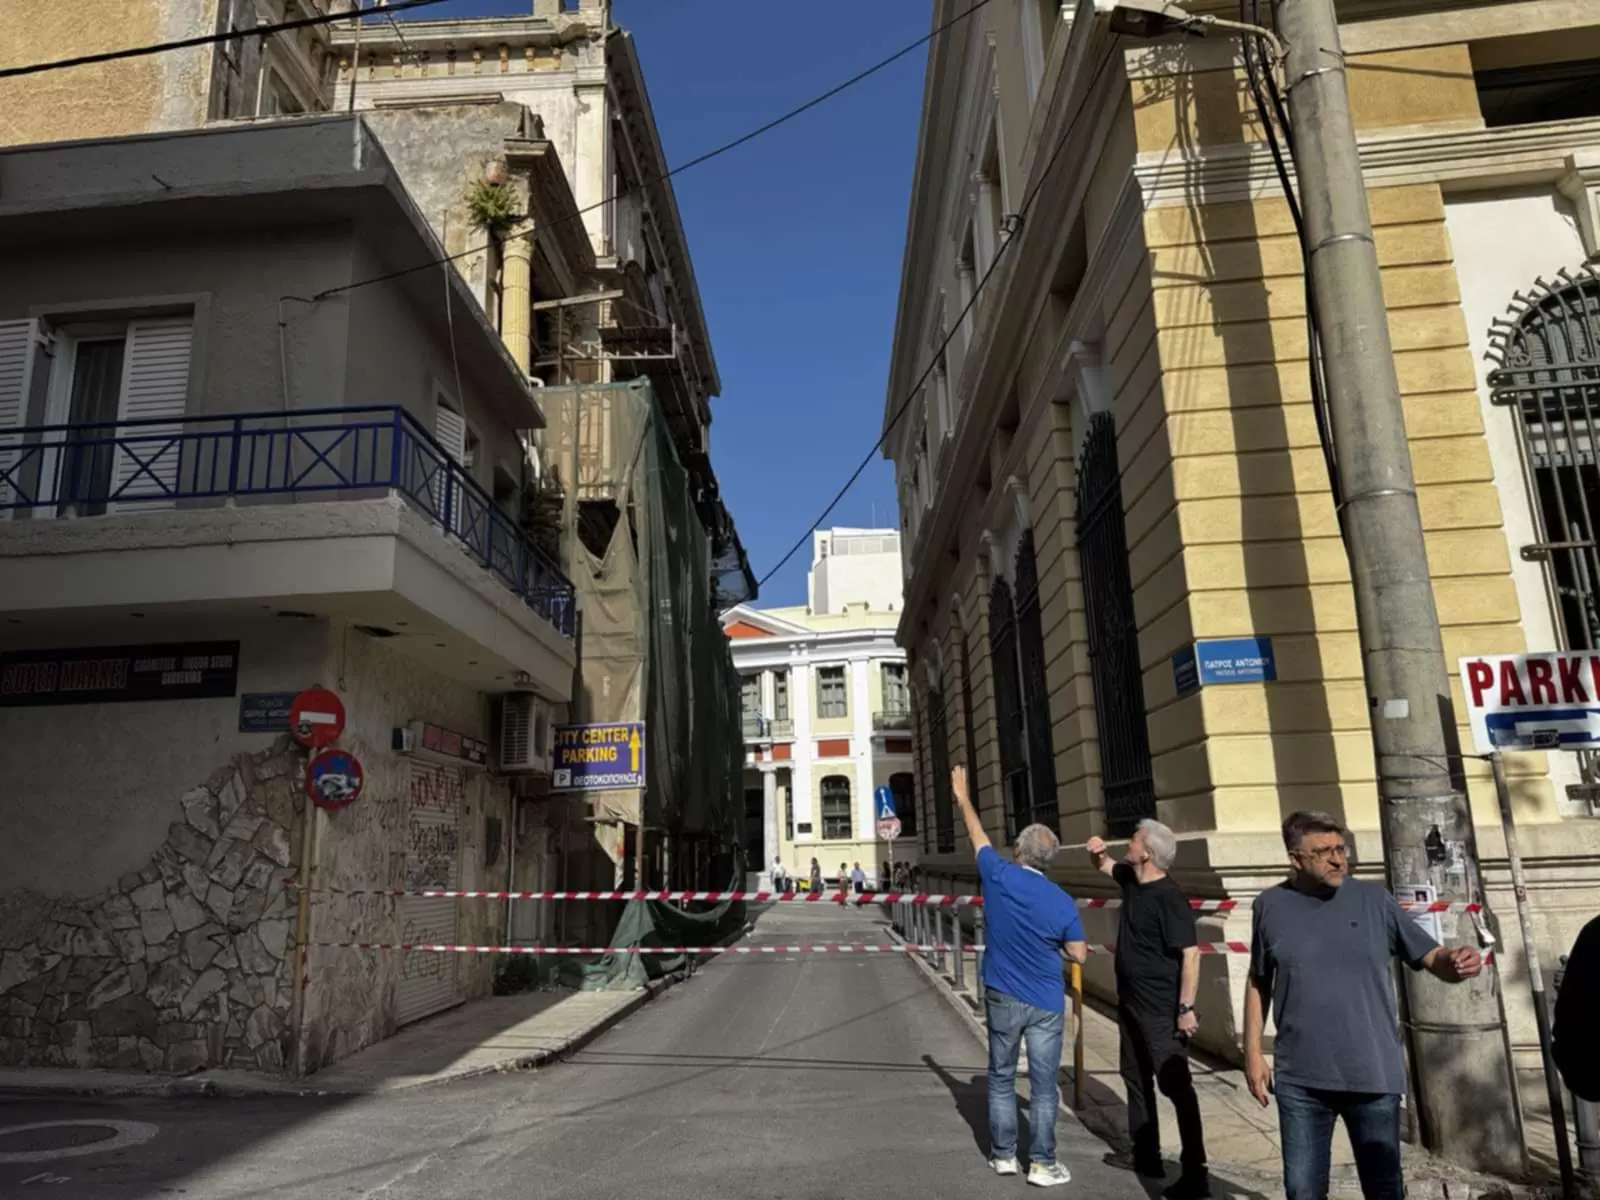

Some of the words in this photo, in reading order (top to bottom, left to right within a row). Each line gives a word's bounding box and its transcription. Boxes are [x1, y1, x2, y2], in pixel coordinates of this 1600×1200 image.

[1, 661, 59, 697] SUPER
[60, 657, 131, 691] MARKET
[582, 727, 629, 745] CENTER
[562, 745, 618, 764] PARKING
